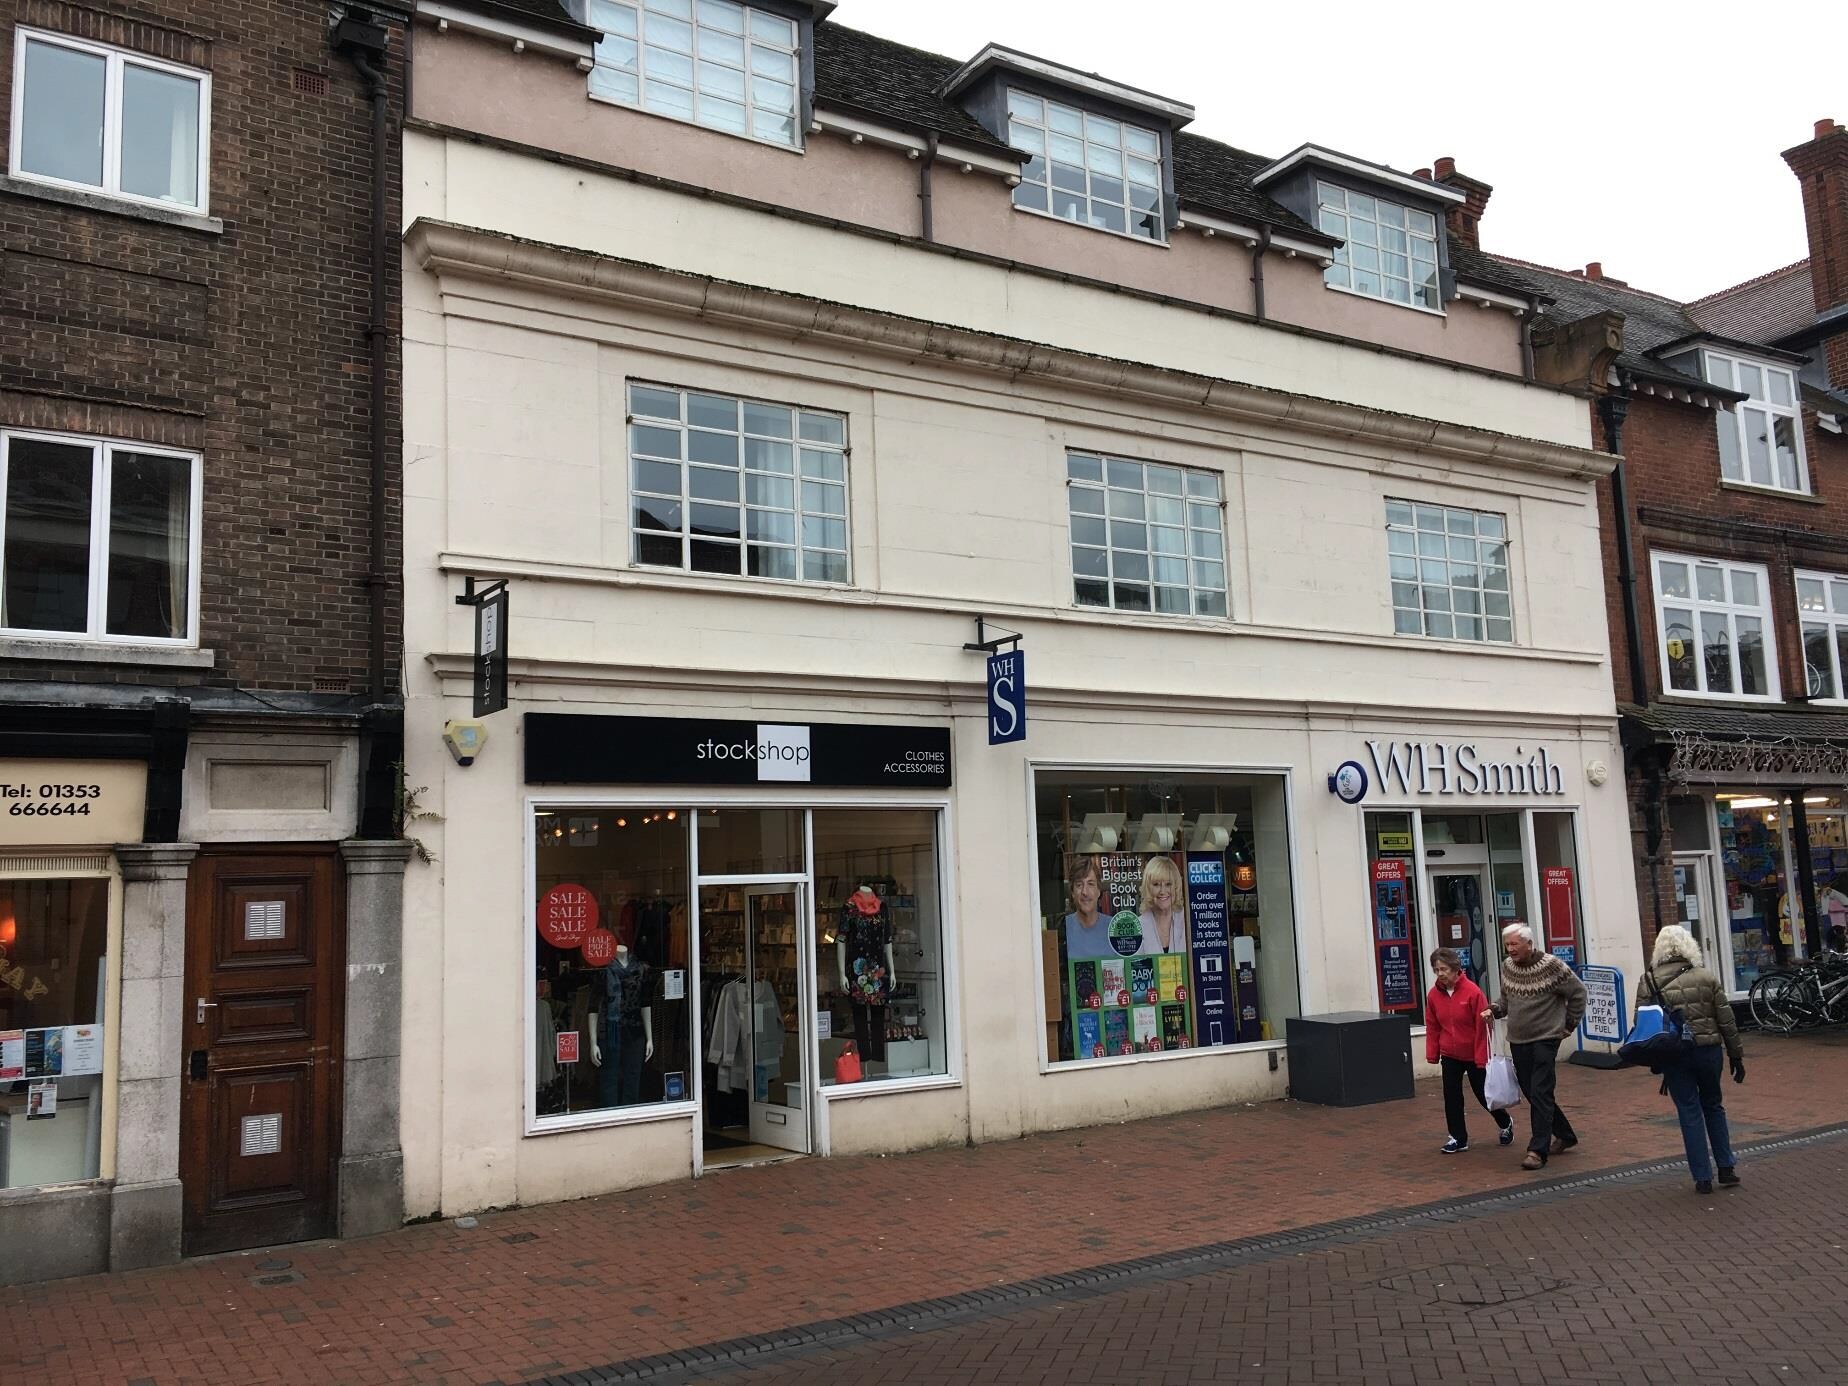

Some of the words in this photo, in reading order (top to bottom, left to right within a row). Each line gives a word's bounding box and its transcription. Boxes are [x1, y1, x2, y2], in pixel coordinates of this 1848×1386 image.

[992, 658, 1014, 678] WH
[993, 676, 1017, 736] S
[905, 750, 945, 762] CLOTHES
[883, 763, 945, 774] ACCESSORIES
[1365, 740, 1565, 794] WHSmith
[0, 783, 32, 798] Tel:
[39, 784, 101, 798] 01353
[9, 802, 91, 816] 666644
[1100, 856, 1142, 868] Britain's
[1377, 862, 1399, 870] GREAT
[1102, 869, 1142, 883] Biggest
[1190, 873, 1222, 884] COLLECT
[1376, 871, 1401, 879] OFFERS
[1110, 882, 1137, 894] Book
[549, 892, 587, 905] SALE
[1112, 895, 1136, 908] Club
[1196, 891, 1217, 901] Order
[1191, 901, 1207, 910] from
[549, 906, 587, 919] SALE
[1194, 911, 1198, 919] 1
[1199, 911, 1222, 919] million
[549, 920, 587, 933] SALE
[1198, 920, 1219, 929] books
[588, 935, 613, 944] HALF
[1196, 930, 1204, 938] in
[1205, 930, 1222, 938] store
[588, 943, 613, 951] PRICE
[1192, 940, 1206, 948] and
[1207, 939, 1228, 948] online
[587, 949, 613, 958] SALE
[1131, 968, 1153, 981] BABY
[1208, 974, 1222, 982] Store
[1385, 975, 1391, 987] 4
[1587, 998, 1596, 1006] UP
[1598, 999, 1607, 1007] TO
[1608, 1000, 1616, 1008] 4P
[1592, 1007, 1605, 1016] OFF
[1606, 1008, 1612, 1016] A
[1588, 1016, 1607, 1025] LITRE
[1608, 1017, 1617, 1026] OF
[1594, 1025, 1612, 1034] FUEL
